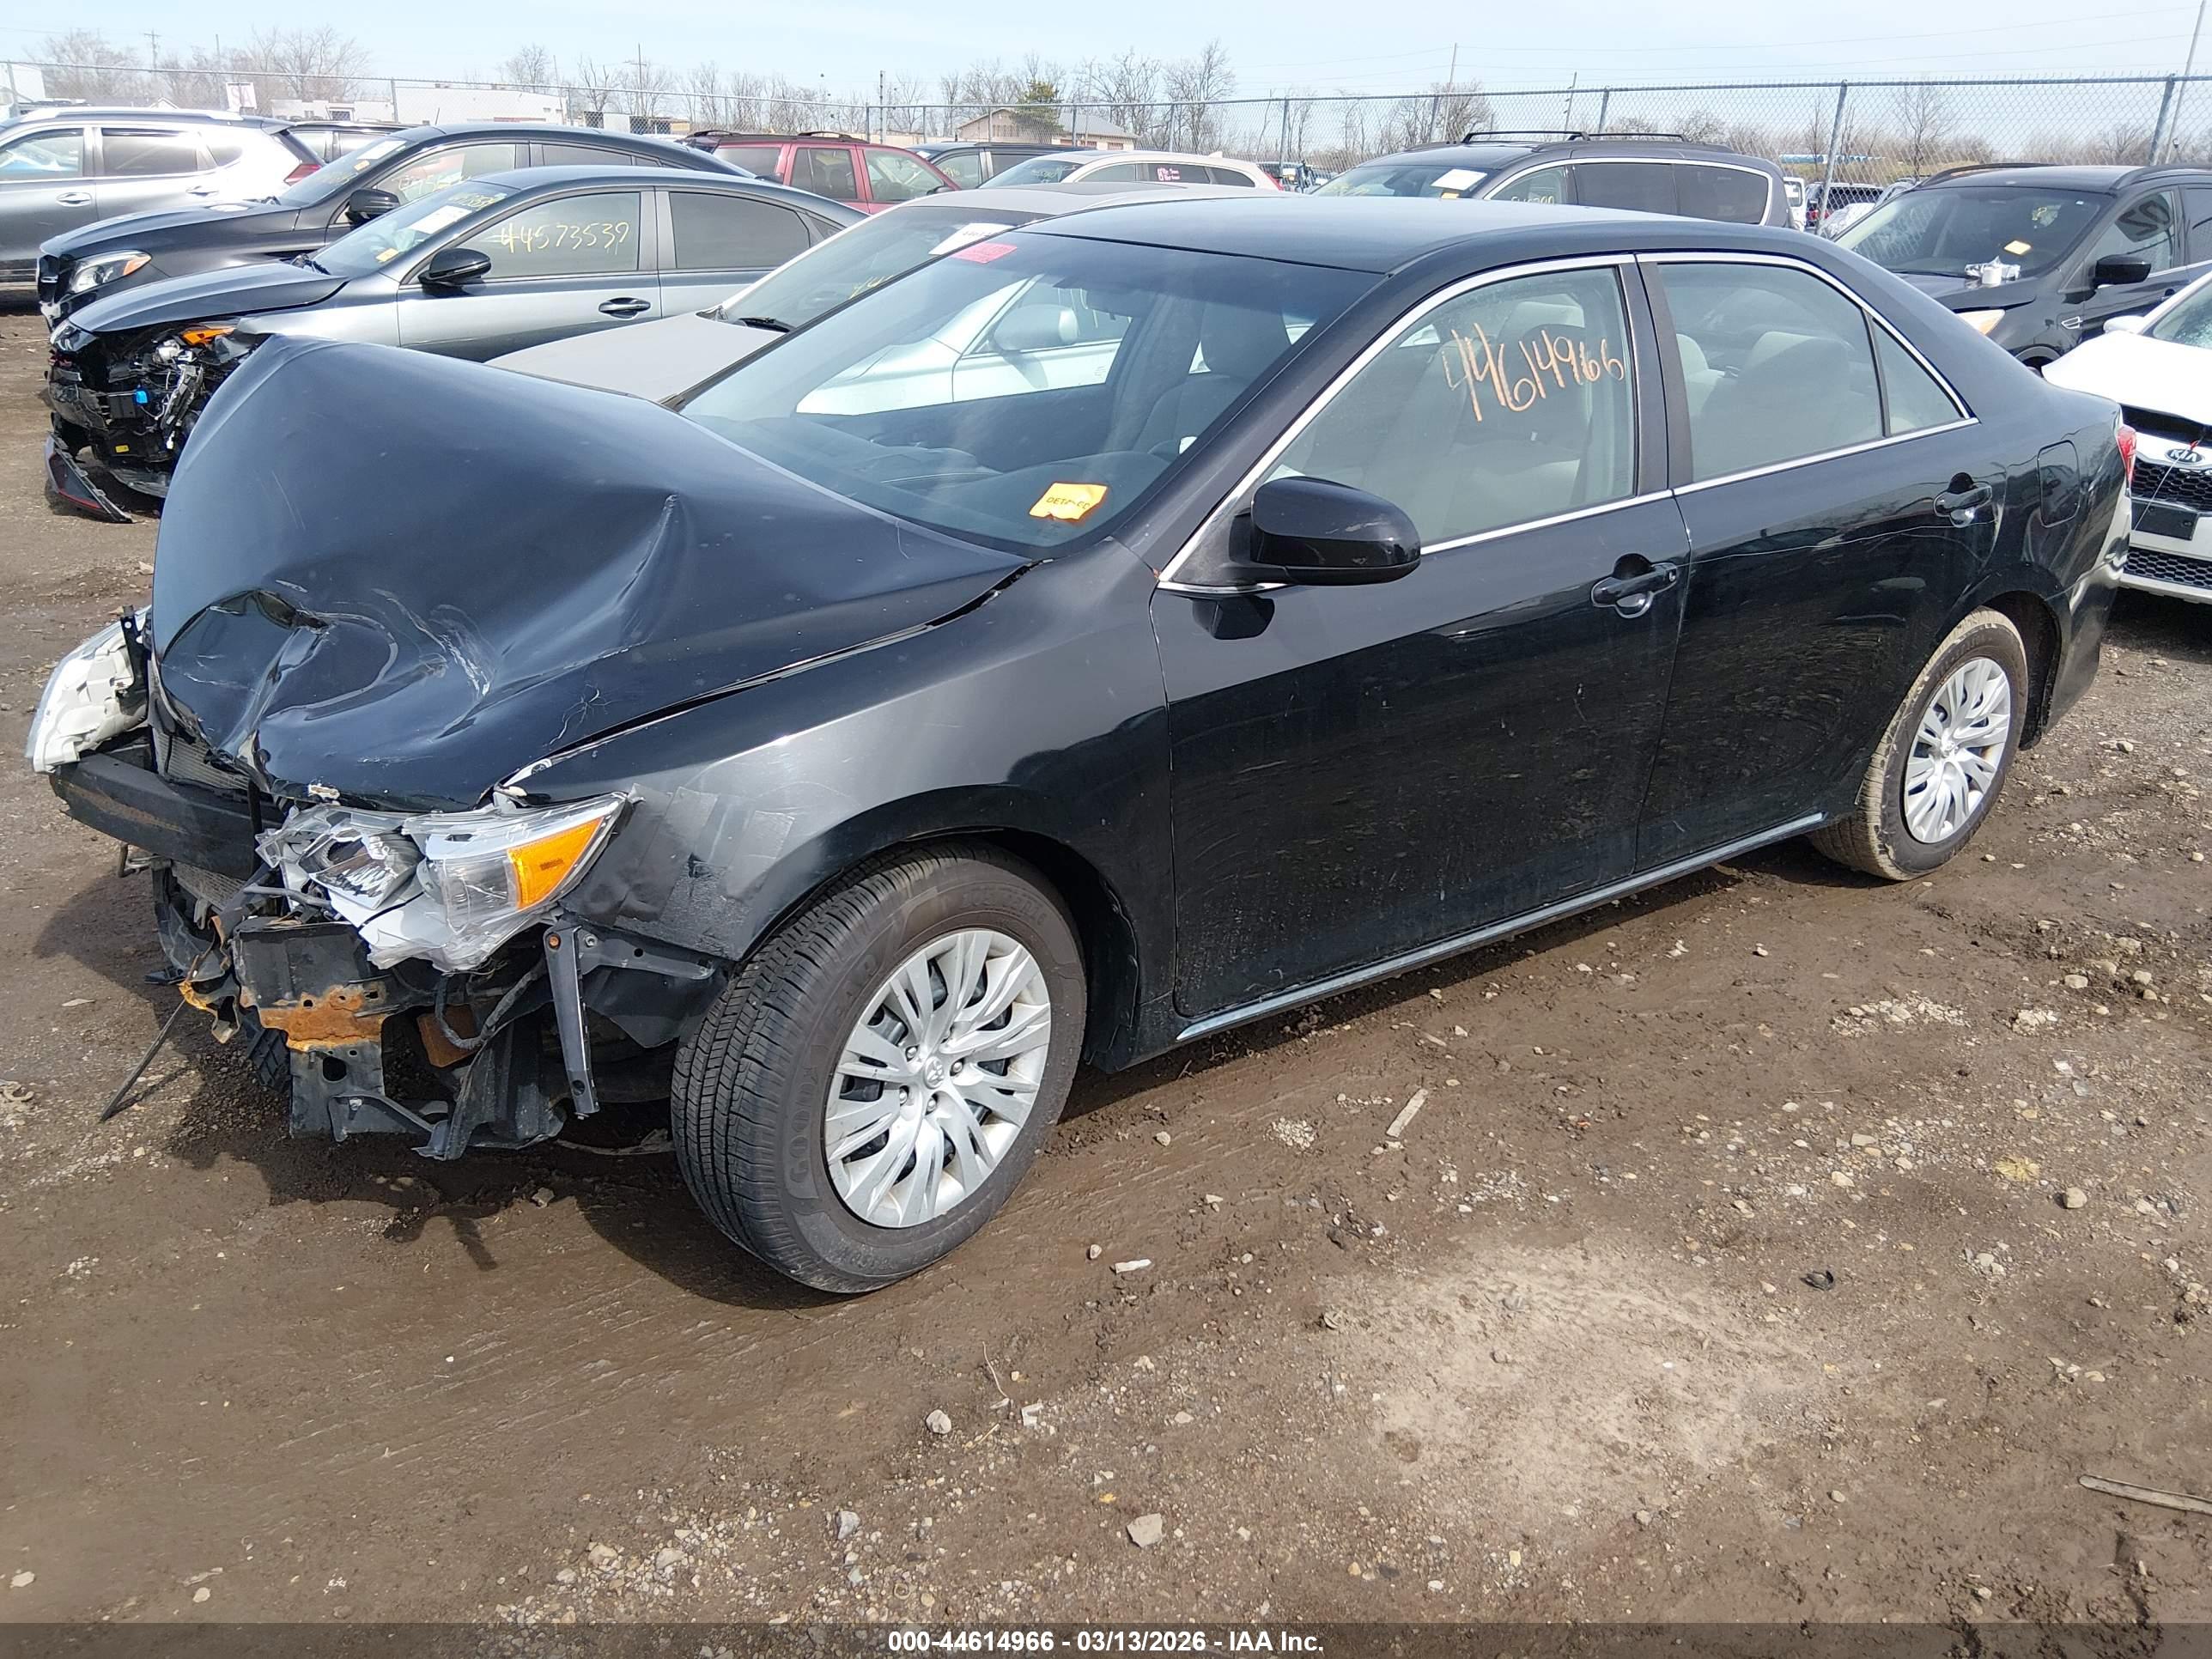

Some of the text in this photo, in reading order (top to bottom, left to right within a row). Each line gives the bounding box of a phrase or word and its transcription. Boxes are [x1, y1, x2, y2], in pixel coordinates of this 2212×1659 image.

[501, 222, 629, 253] 44573539
[1441, 323, 1626, 422] 44614966
[2169, 449, 2198, 463] KIA
